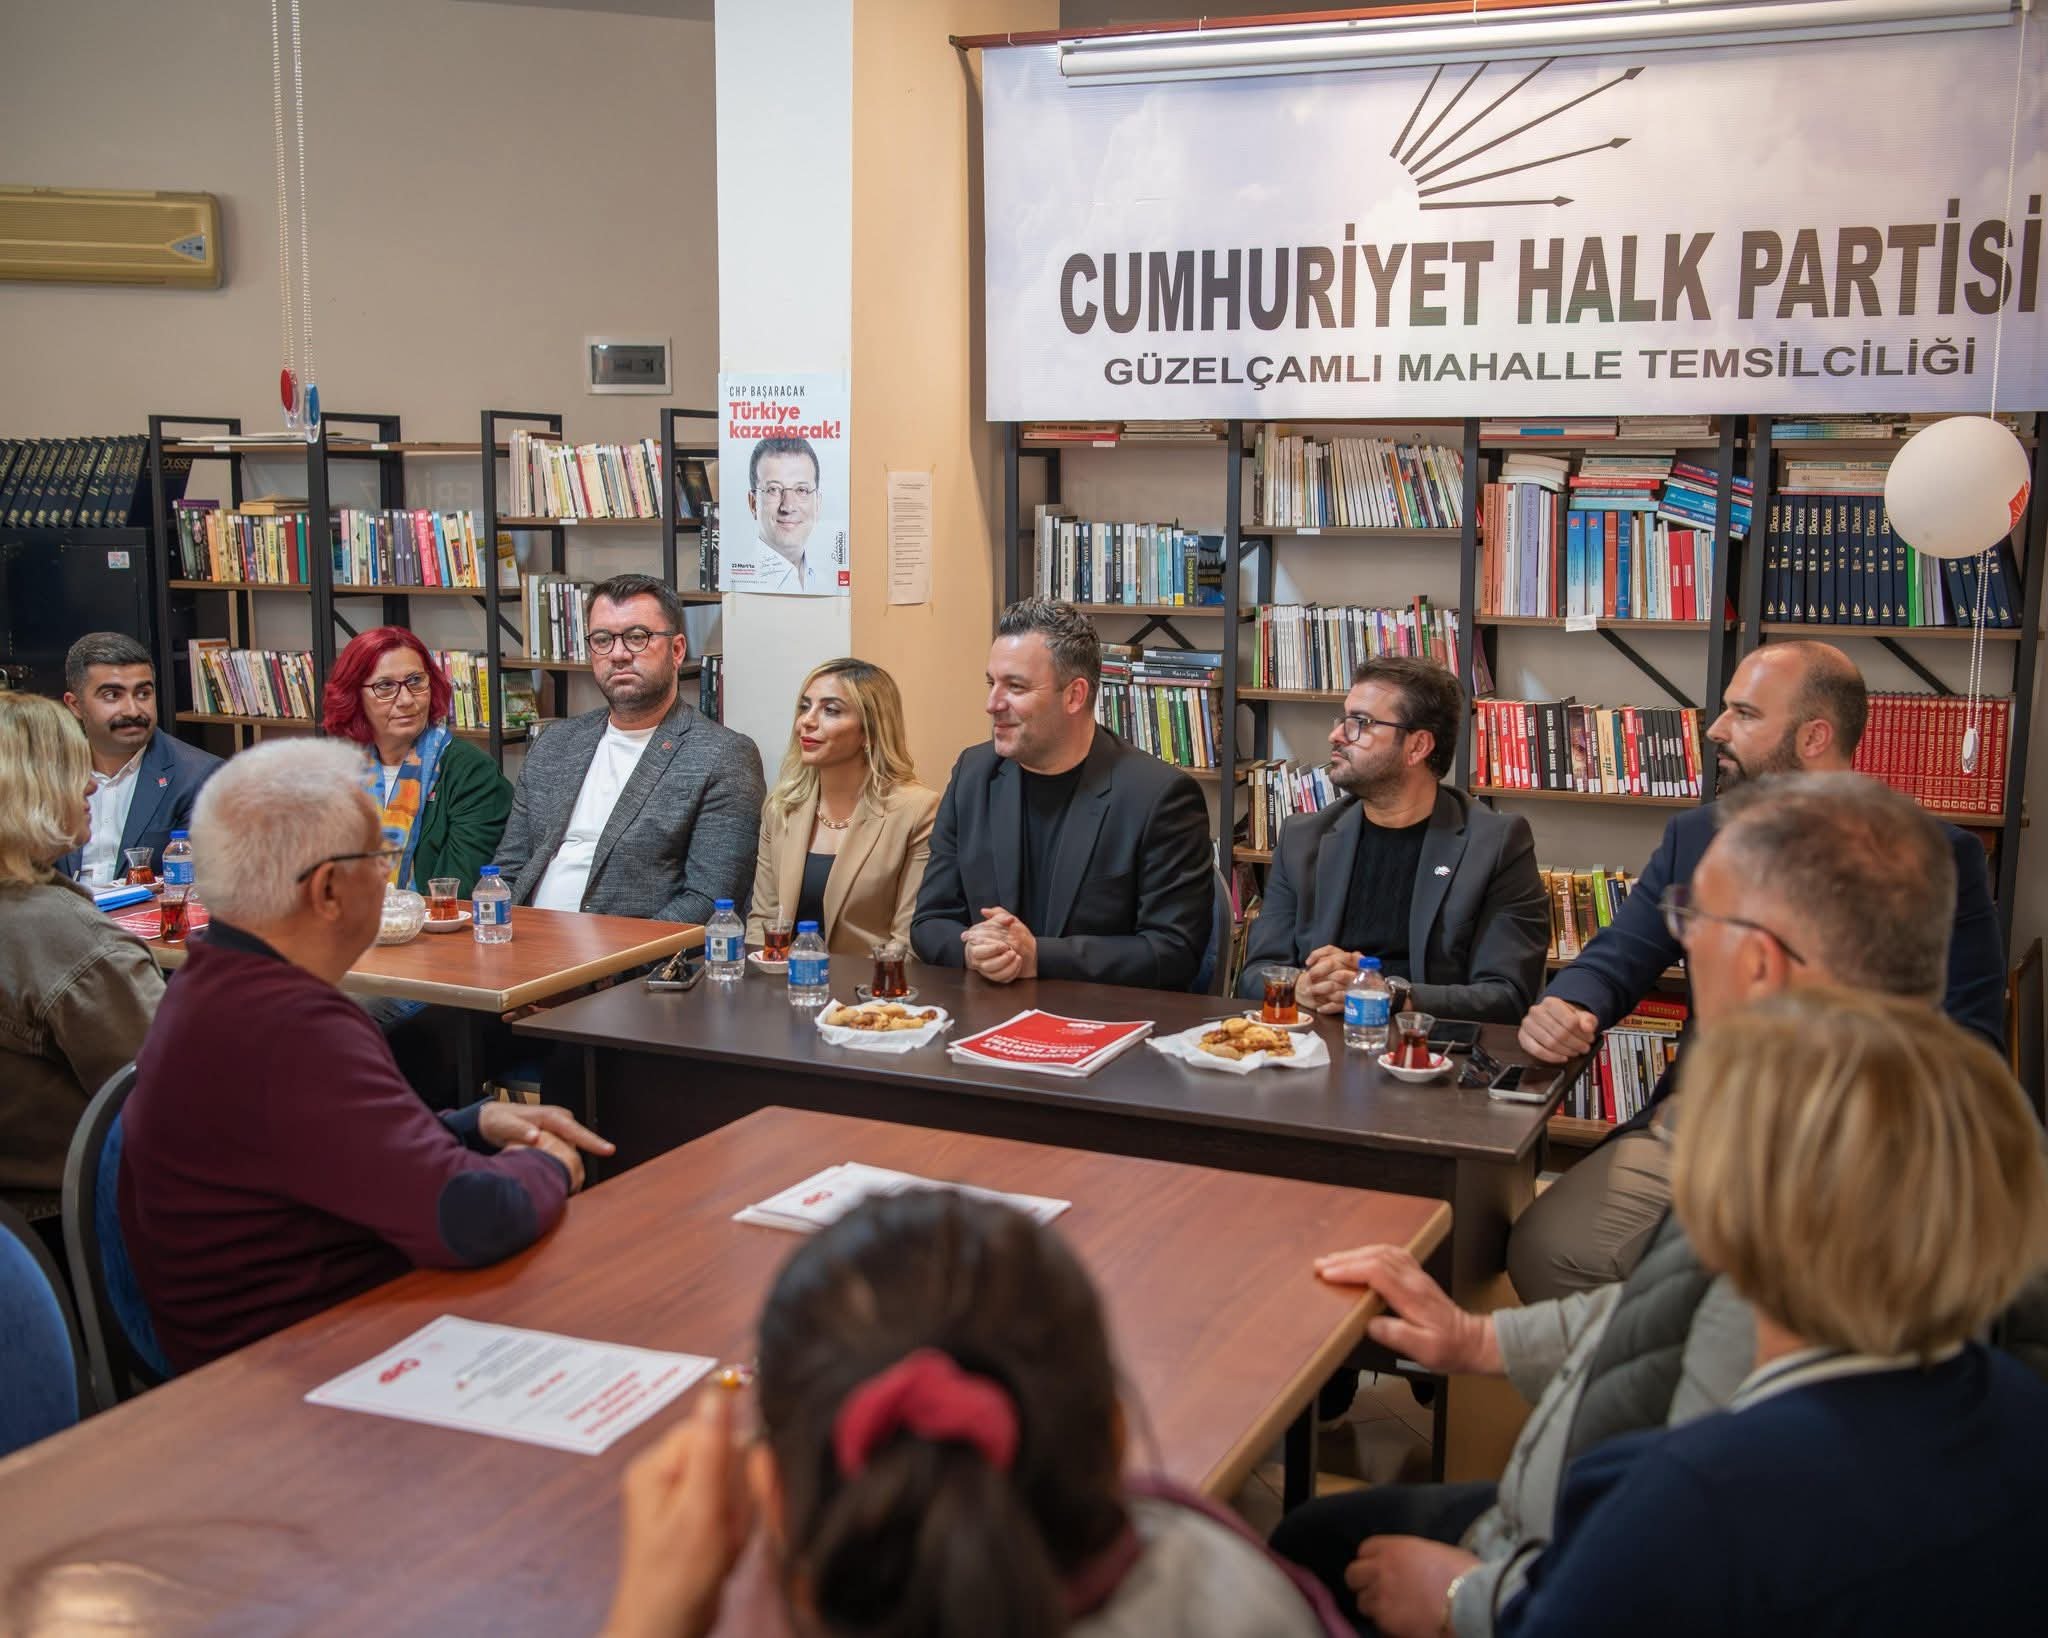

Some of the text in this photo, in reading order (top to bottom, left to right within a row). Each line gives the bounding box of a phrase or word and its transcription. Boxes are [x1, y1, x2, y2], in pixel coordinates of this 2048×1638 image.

[1060, 195, 2042, 334] CUMHURİYET HALK PARTİSİ
[1104, 337, 1977, 391] GÜZELÇAMLI MAHALLE TEMSİLCİLİĞİ
[729, 386, 805, 398] CHP BAŞARACAK
[729, 401, 800, 424] Türkiye
[729, 420, 840, 439] kazanacak!
